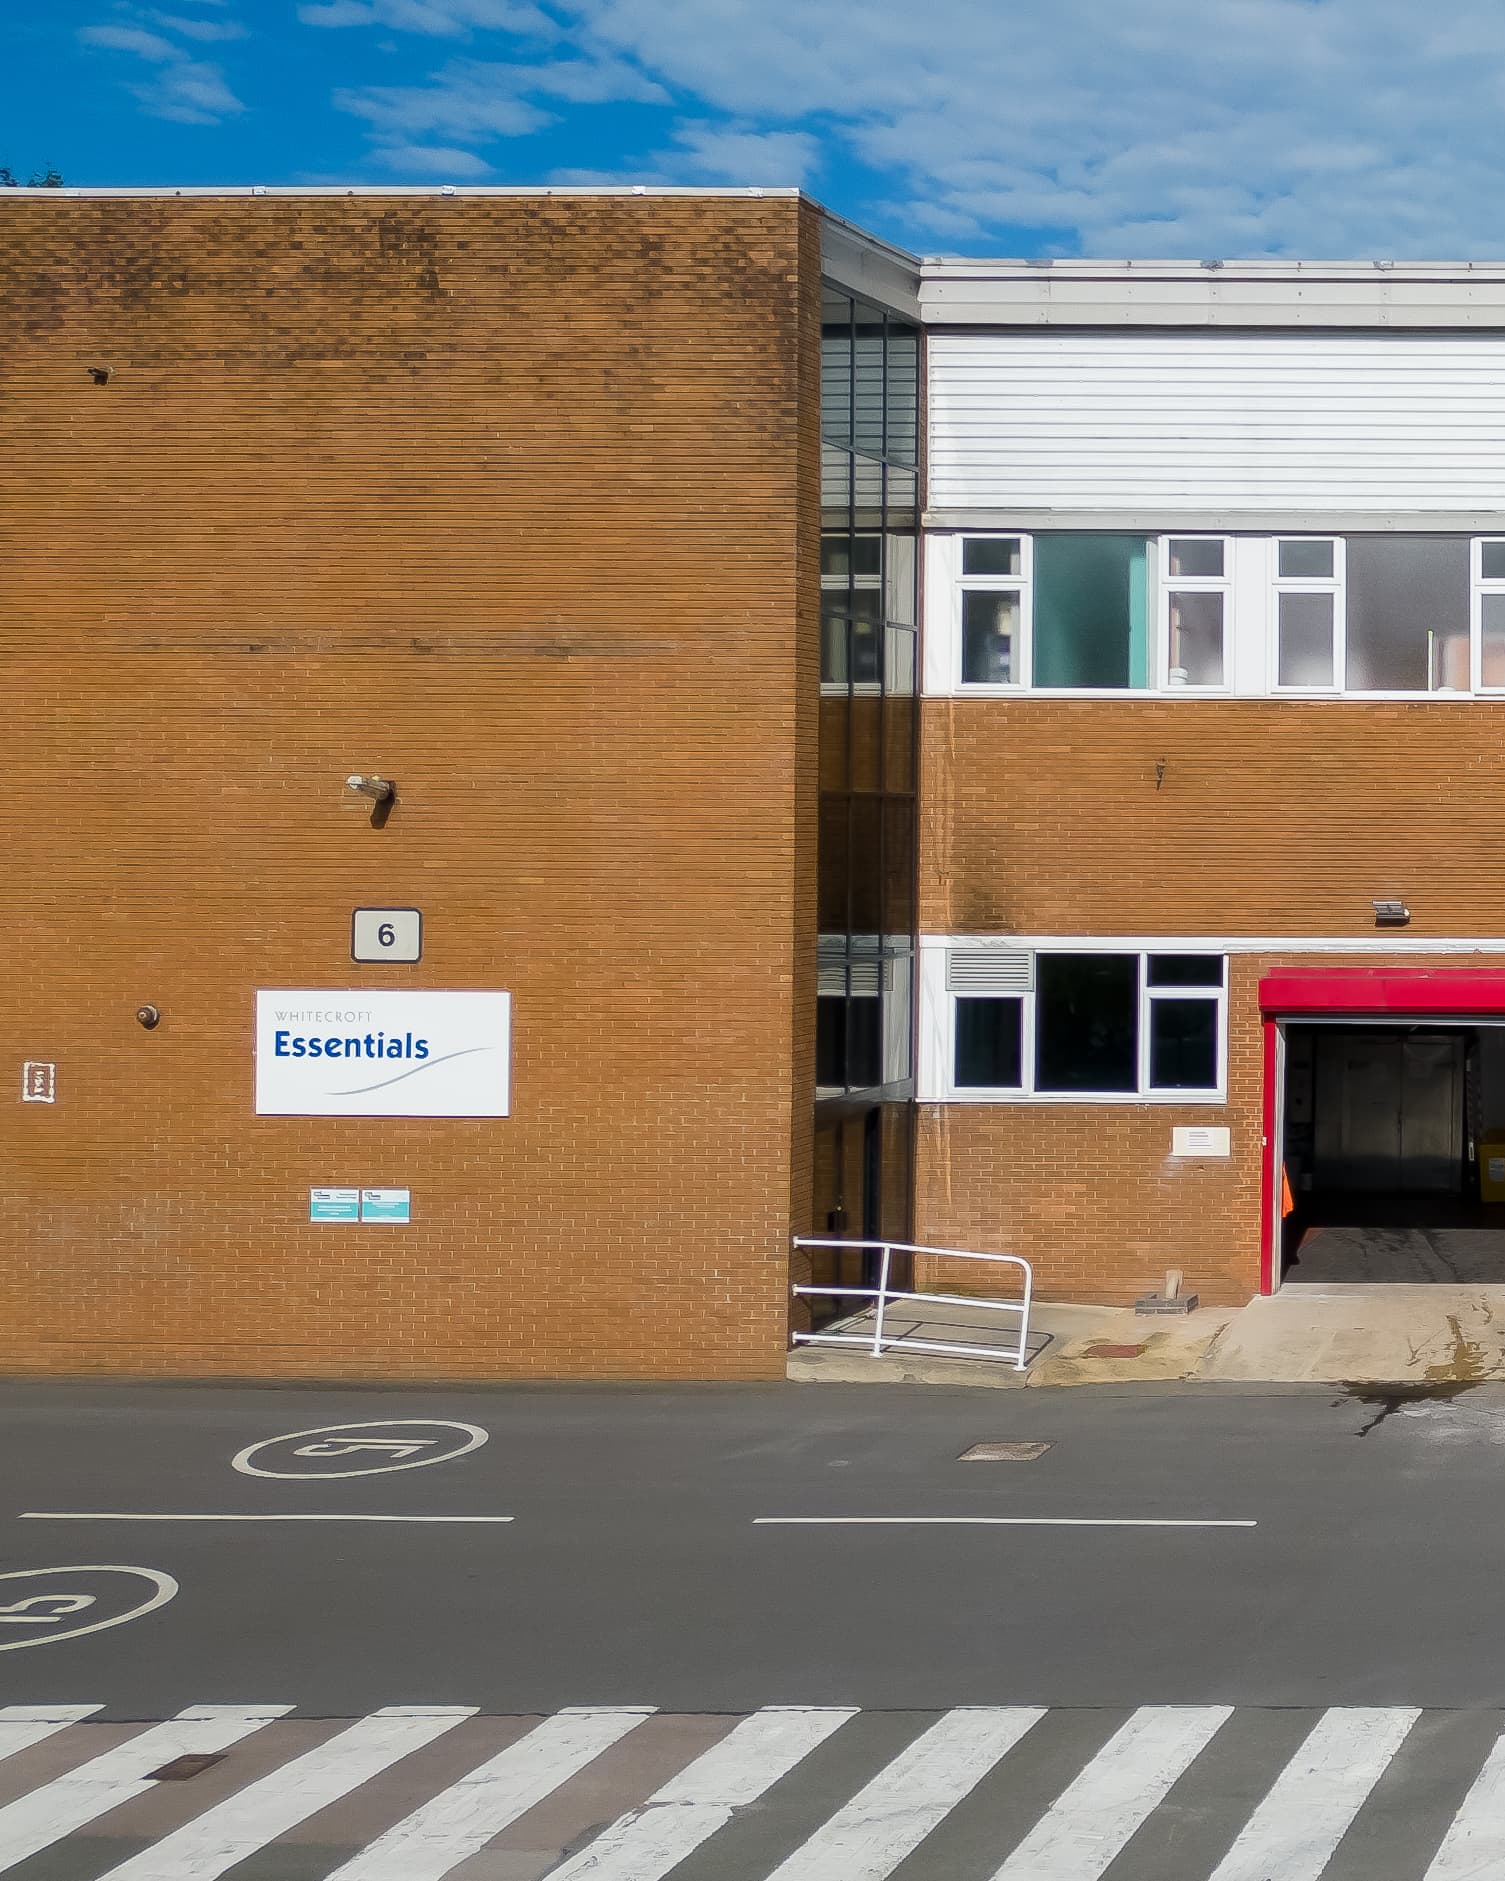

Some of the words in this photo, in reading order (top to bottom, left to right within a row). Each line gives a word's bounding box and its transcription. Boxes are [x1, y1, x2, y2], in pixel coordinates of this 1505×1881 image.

[377, 923, 396, 947] 6
[274, 1011, 373, 1023] WHITECROFT
[275, 1030, 429, 1060] Essentials
